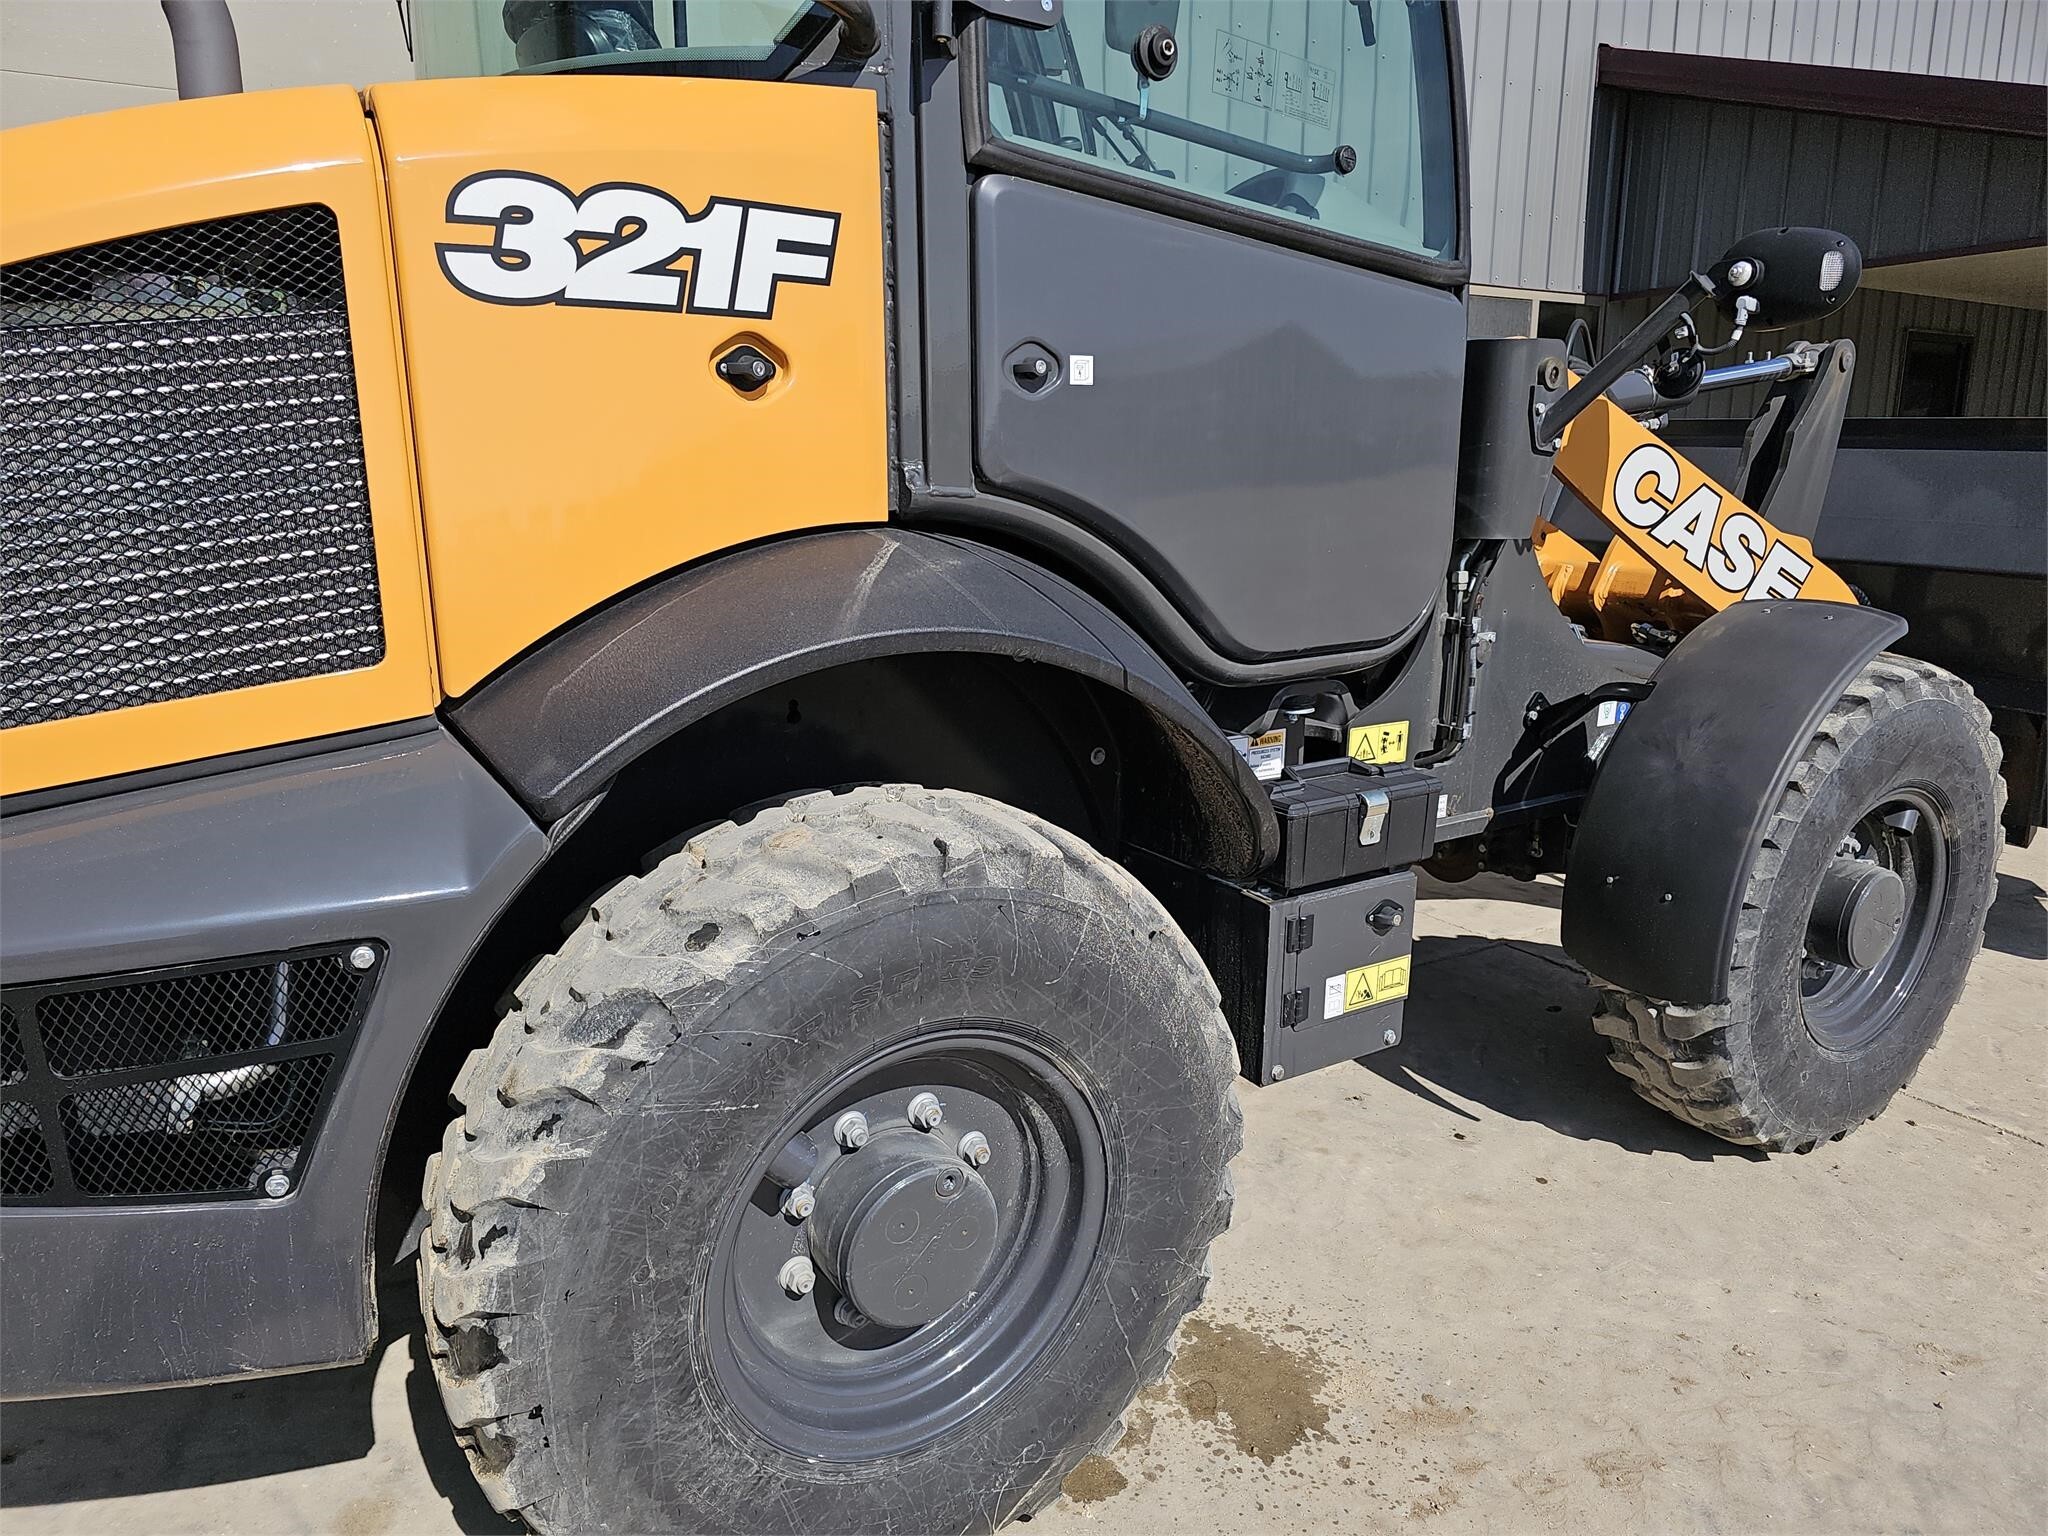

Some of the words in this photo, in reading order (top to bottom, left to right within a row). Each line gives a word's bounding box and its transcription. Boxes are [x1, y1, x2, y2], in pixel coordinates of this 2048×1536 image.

[435, 169, 841, 320] 321F
[1613, 443, 1813, 600] CASE
[1259, 734, 1282, 746] WARNING
